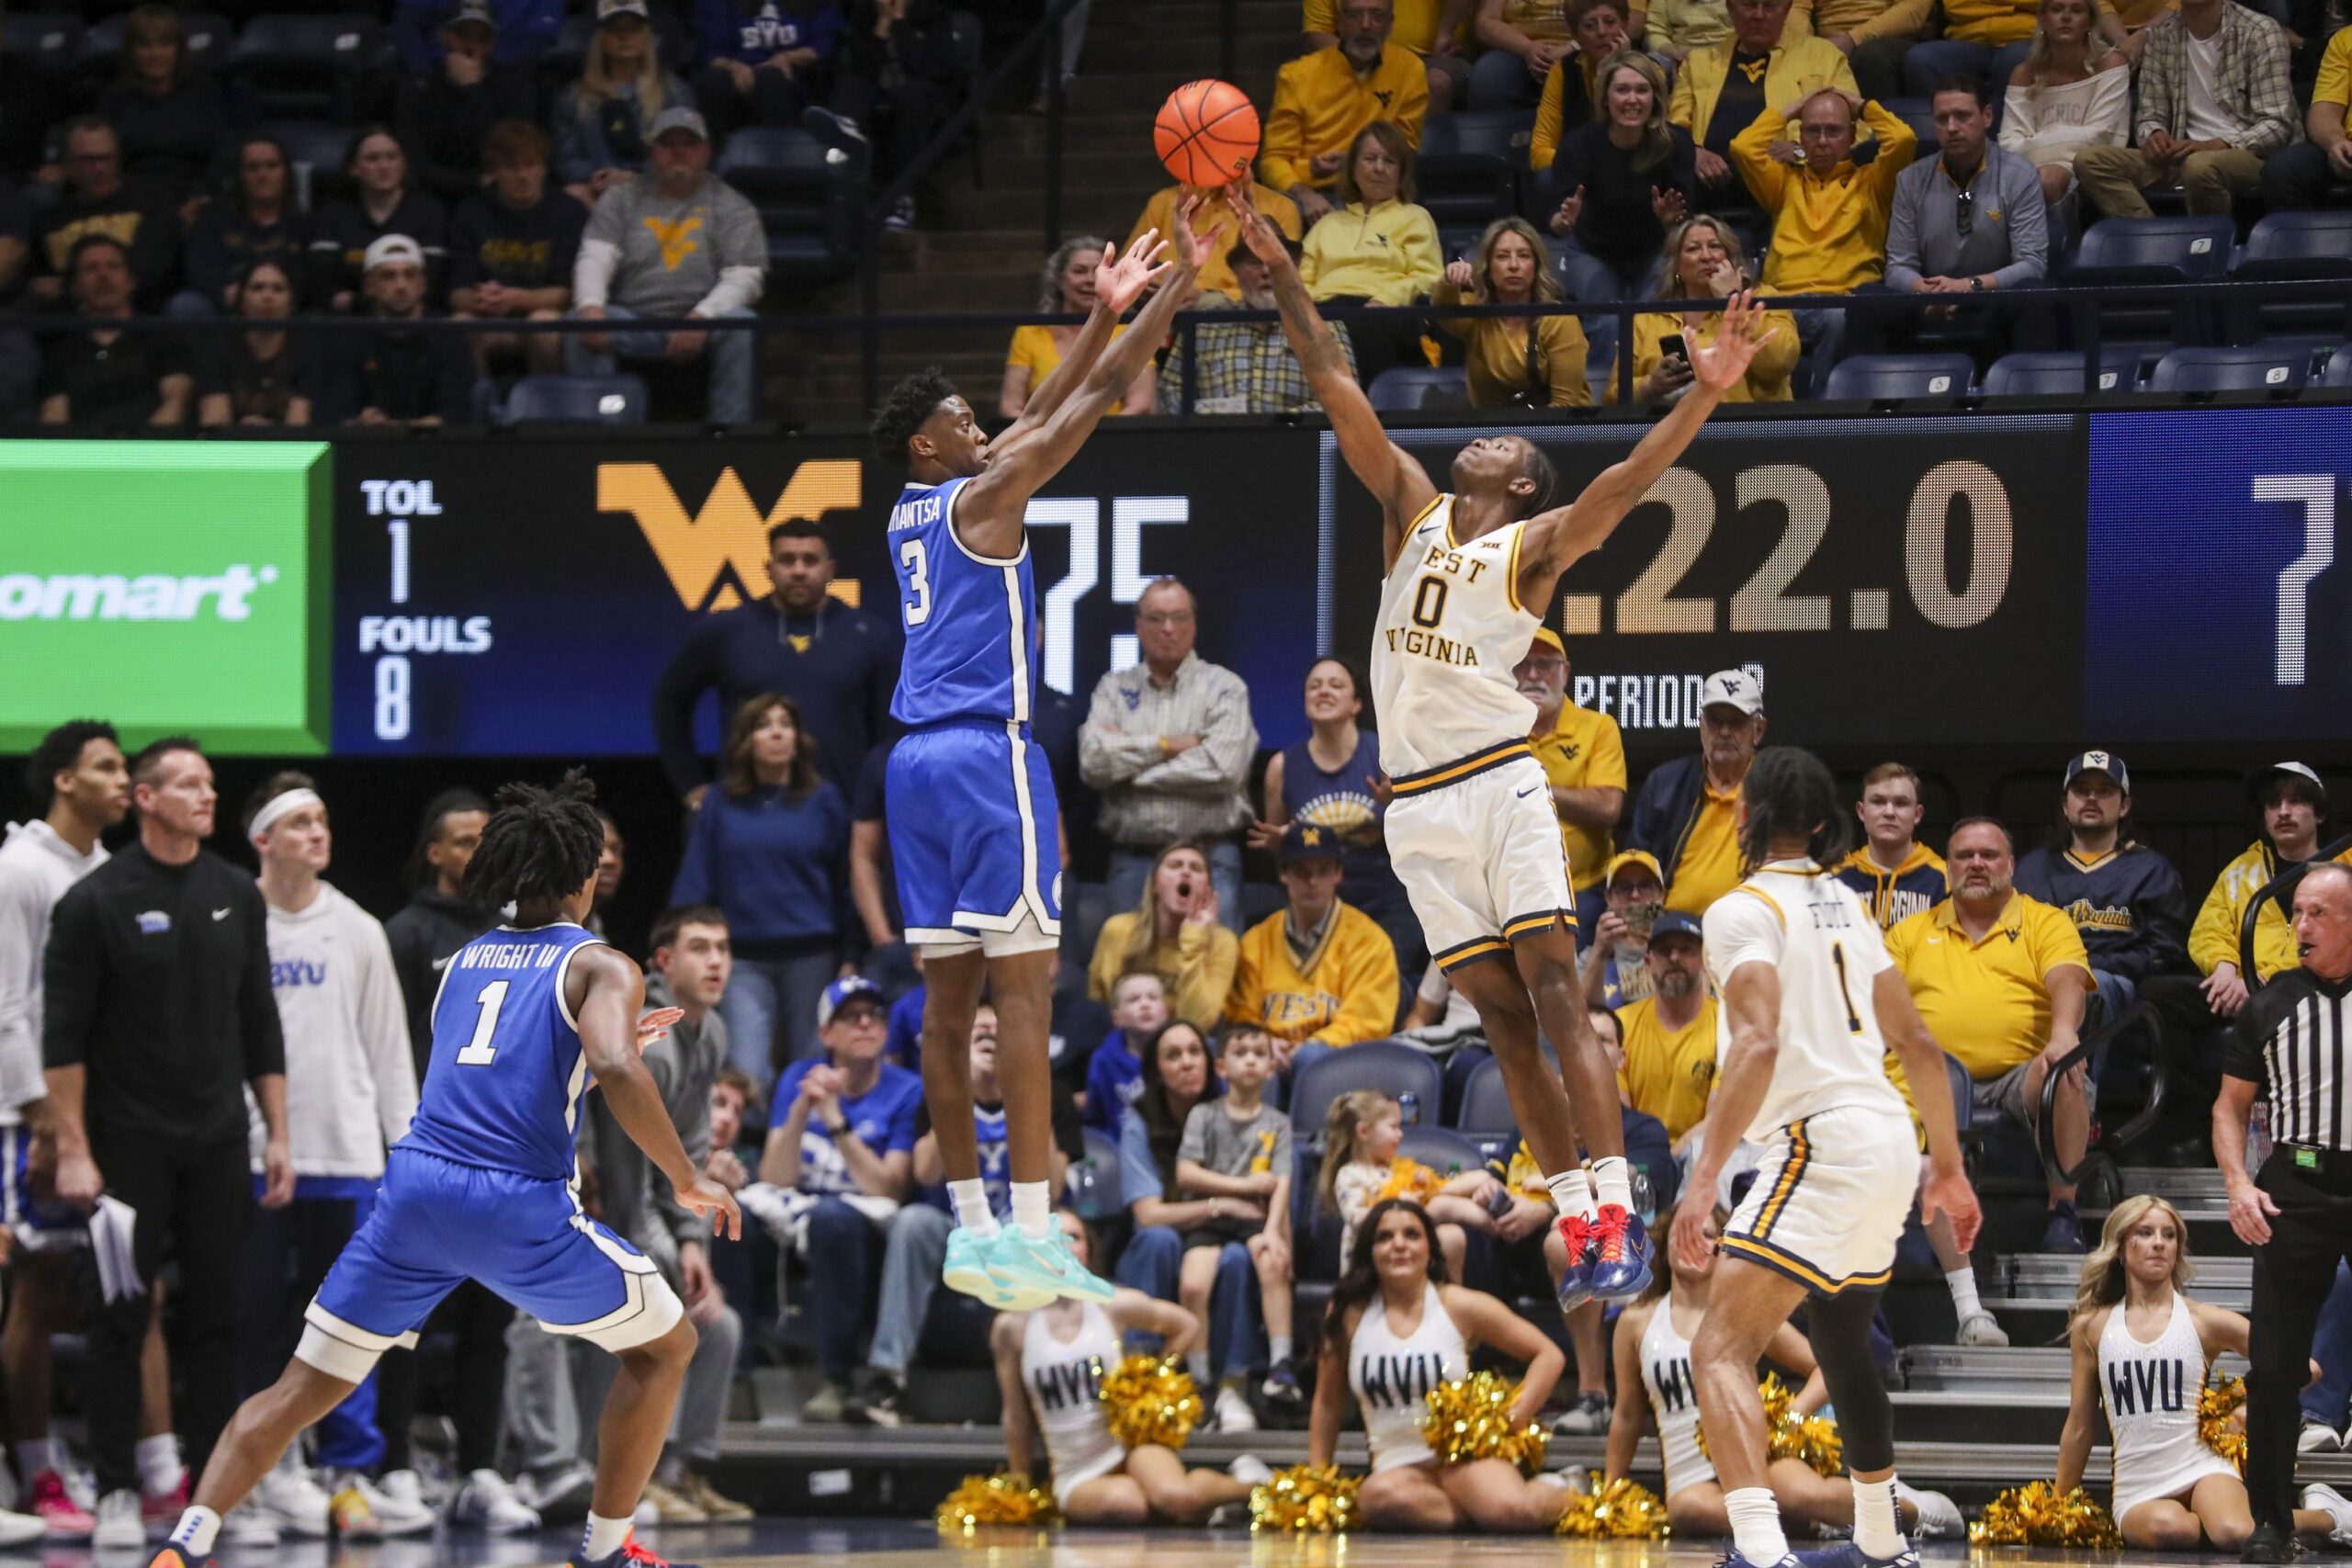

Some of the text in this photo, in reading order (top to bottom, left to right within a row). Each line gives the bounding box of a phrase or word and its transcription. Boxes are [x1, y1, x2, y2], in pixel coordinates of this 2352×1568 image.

[360, 479, 443, 516] TOL
[387, 519, 409, 603] 1
[899, 537, 931, 626] 3
[1423, 544, 1487, 584] EST
[2252, 473, 2352, 686] 7
[359, 616, 493, 654] FOULS
[1411, 572, 1450, 630] 0
[373, 655, 411, 741] 8
[460, 943, 563, 969] WRIGHT III
[1831, 940, 1864, 1034] 1
[455, 979, 511, 1066] 1
[2109, 1359, 2184, 1416] WVU
